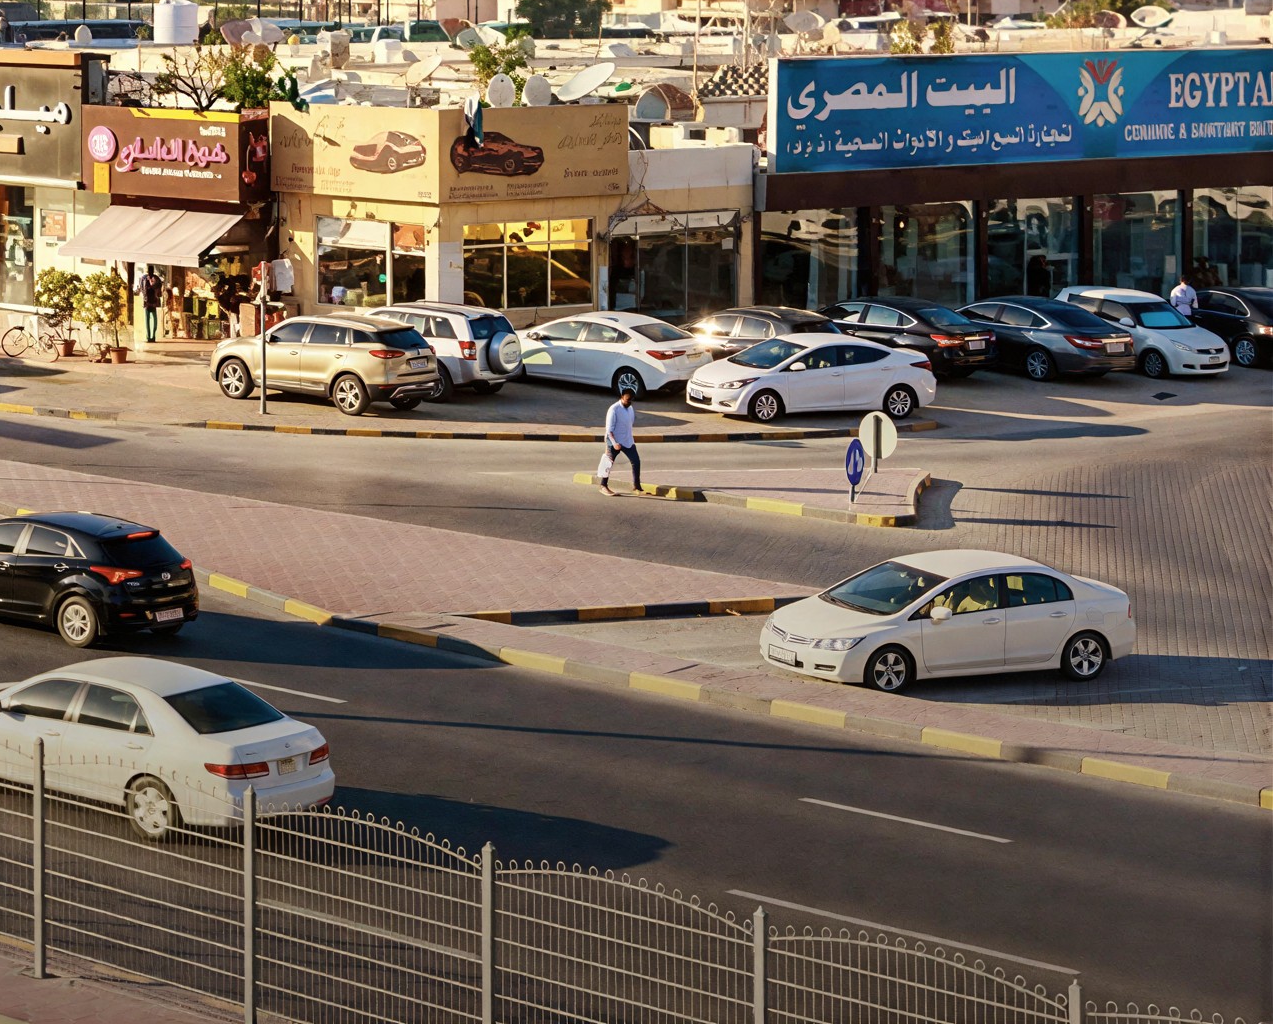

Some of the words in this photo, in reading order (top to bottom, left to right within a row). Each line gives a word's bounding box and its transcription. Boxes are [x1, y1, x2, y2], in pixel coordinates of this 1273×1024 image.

[787, 70, 918, 130] المصري
[926, 67, 1016, 115] البيت
[1168, 71, 1273, 108] EGYPTA
